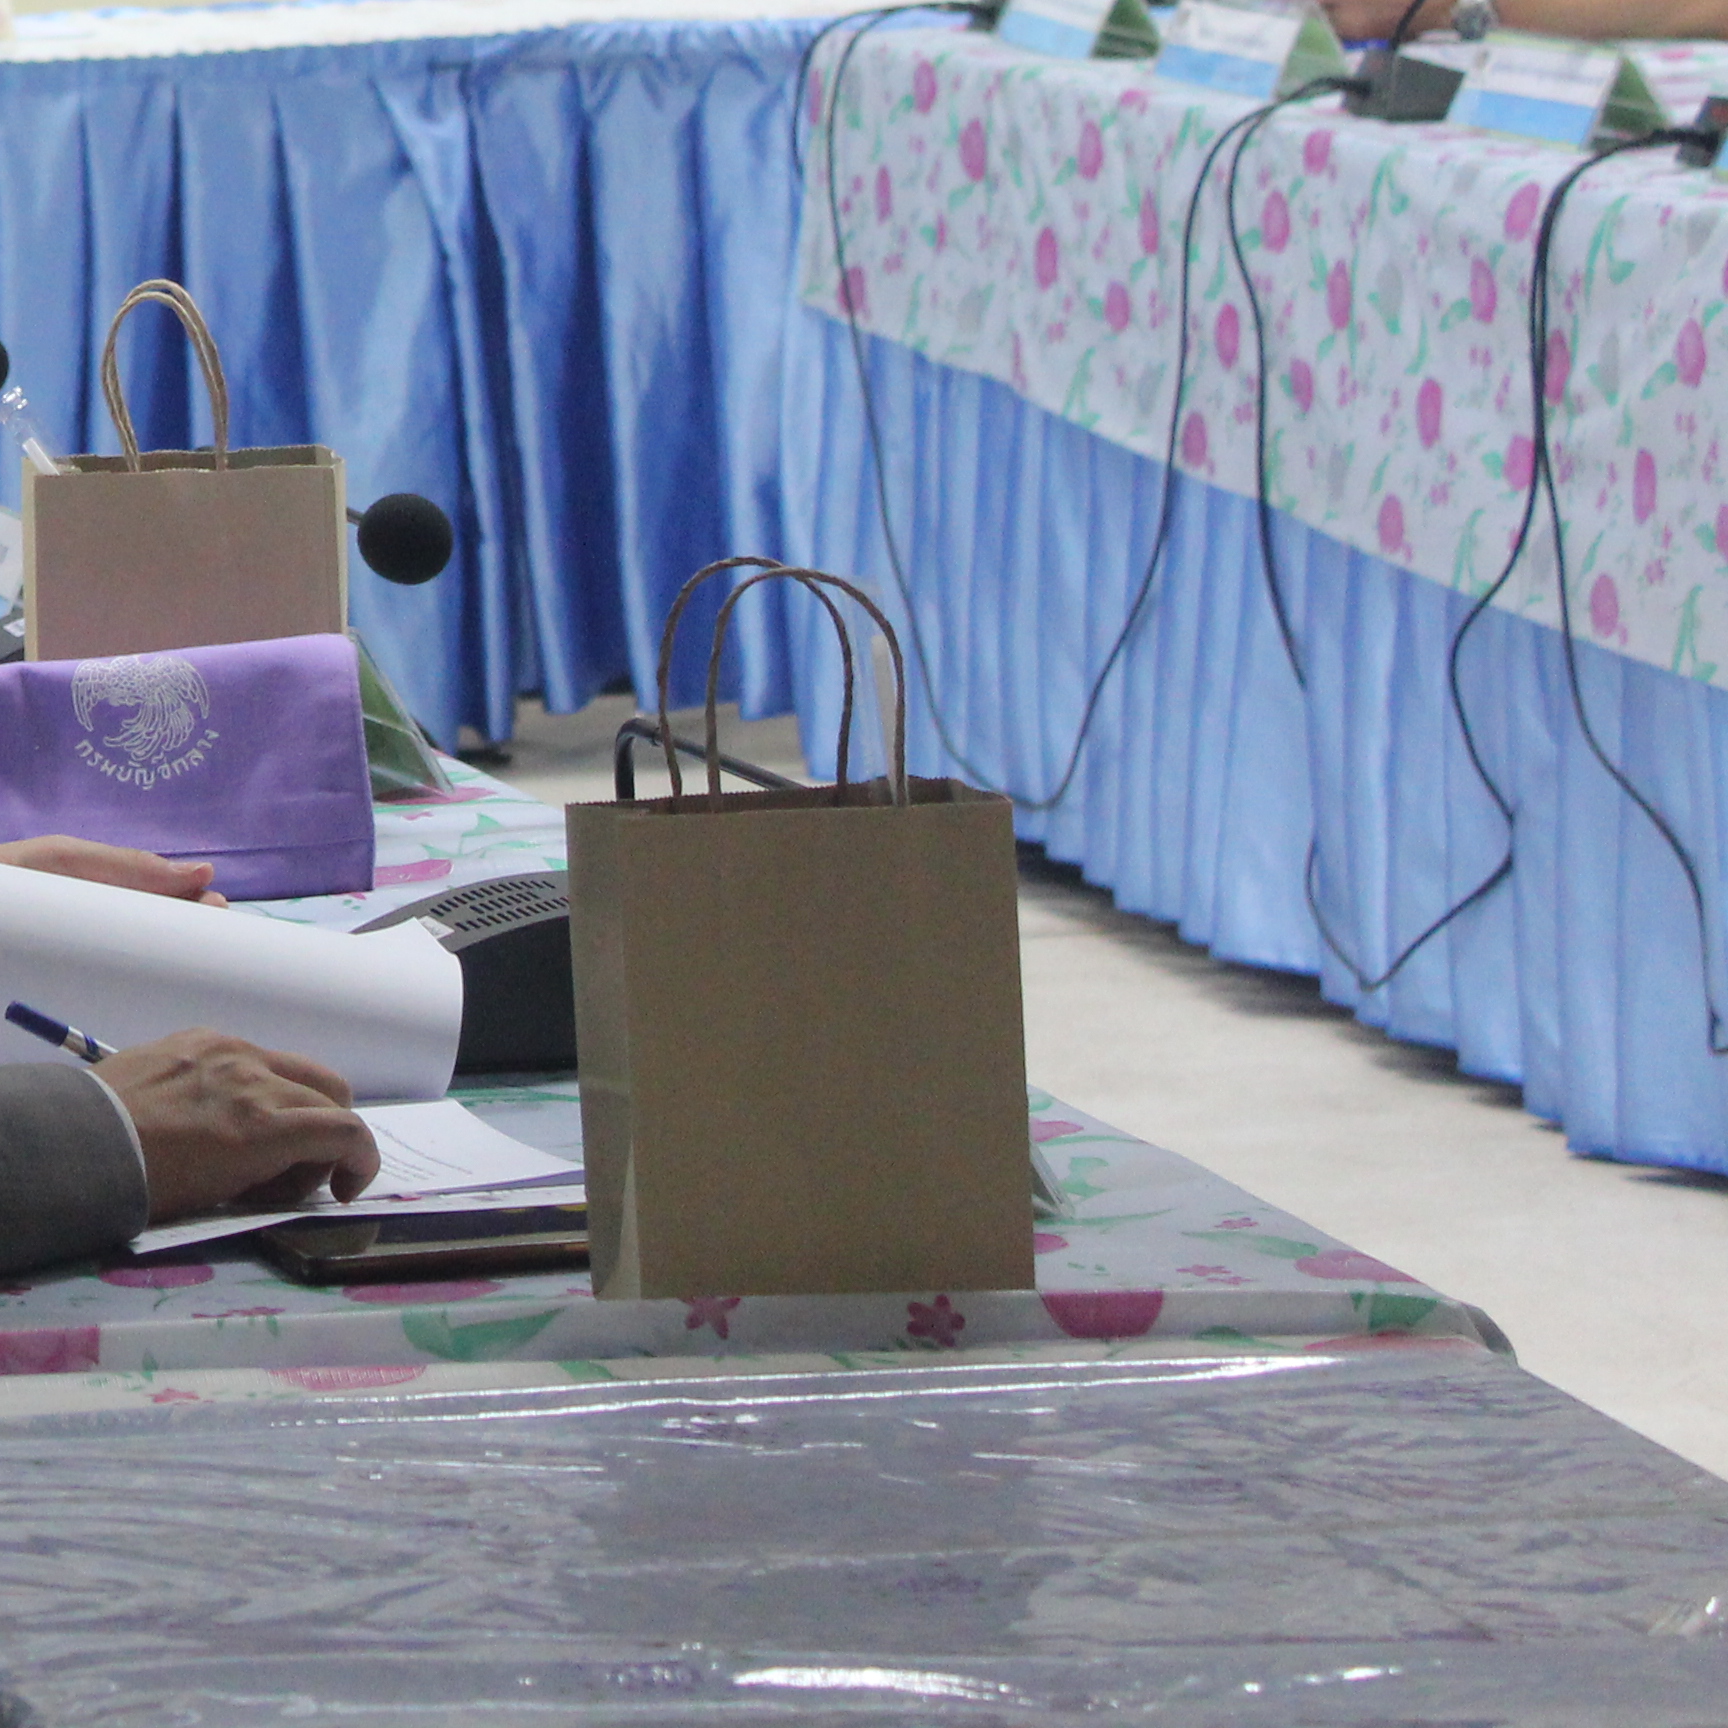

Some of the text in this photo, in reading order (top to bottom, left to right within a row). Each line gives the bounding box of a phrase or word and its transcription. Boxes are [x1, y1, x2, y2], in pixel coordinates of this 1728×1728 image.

[74, 728, 220, 790] กรมบัญชีกลาง
